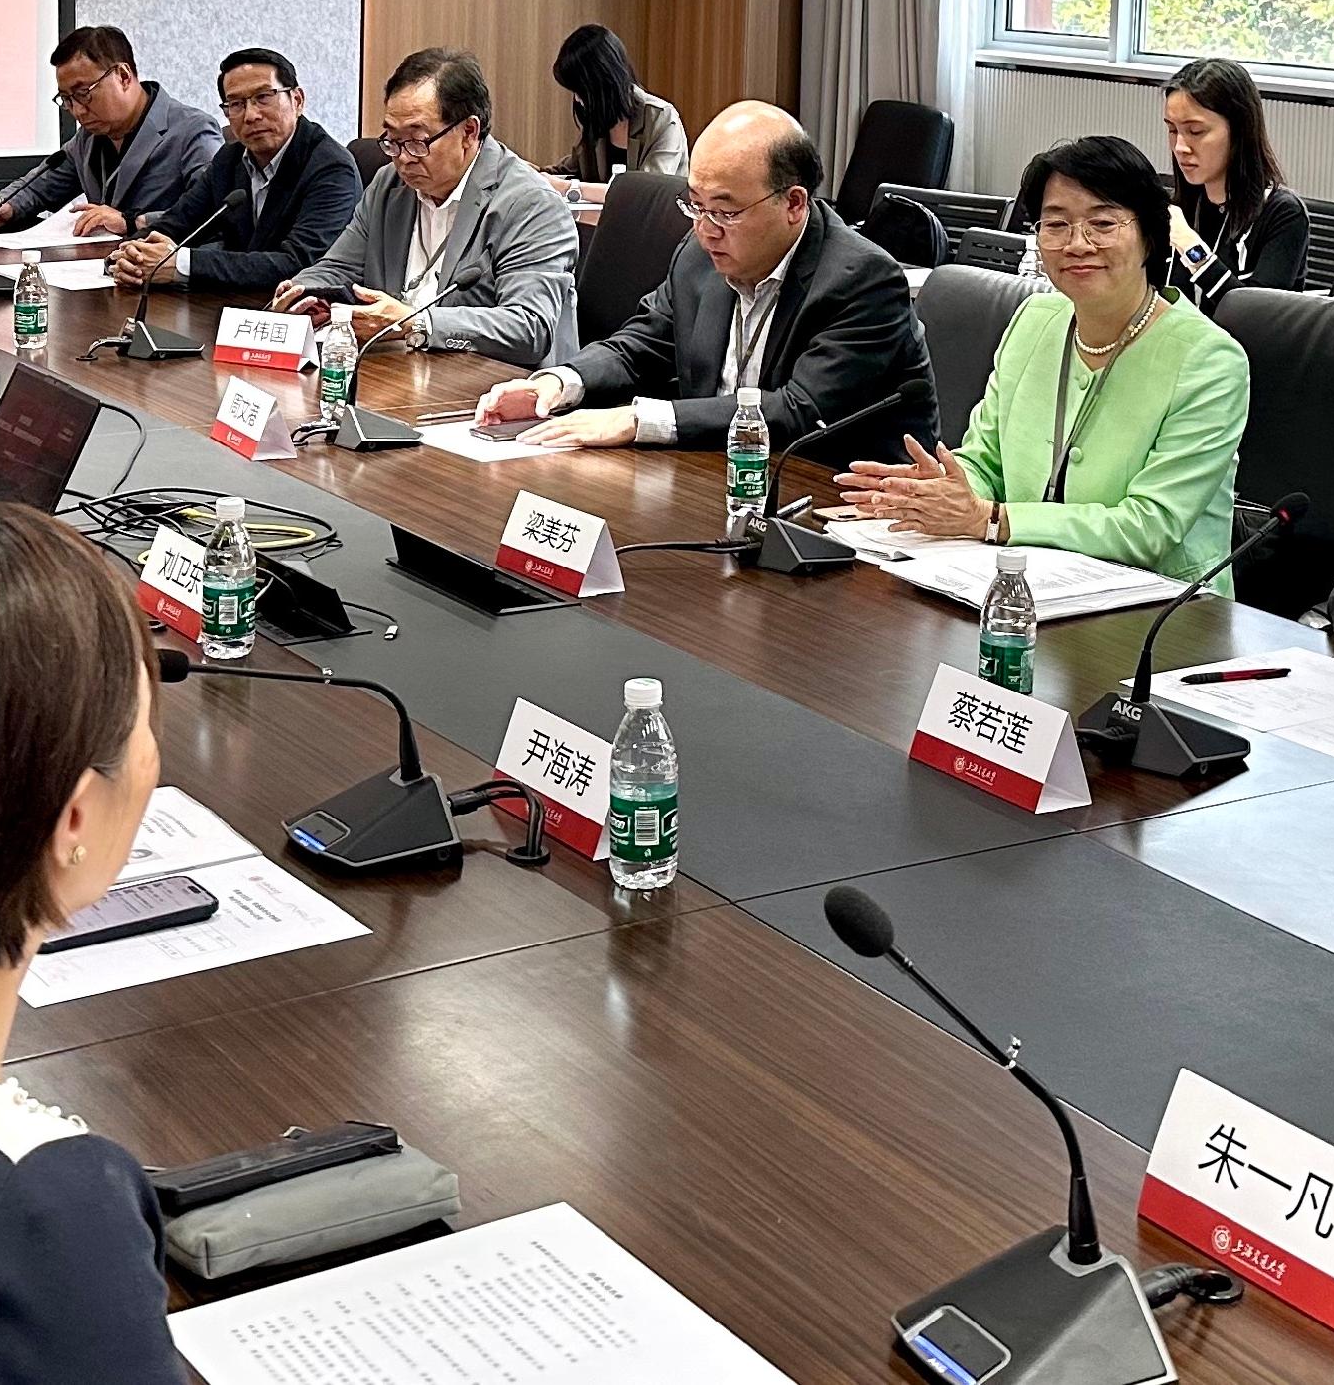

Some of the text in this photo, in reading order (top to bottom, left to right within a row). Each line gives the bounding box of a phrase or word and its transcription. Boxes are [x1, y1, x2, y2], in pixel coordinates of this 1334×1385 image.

[234, 318, 289, 343] 卢伟国
[522, 510, 581, 552] 梁美芬
[158, 547, 204, 594] 刘卫东
[948, 691, 1033, 754] 蔡若莲
[1111, 700, 1142, 722] AKG
[522, 729, 596, 796] 尹海涛
[1198, 1124, 1334, 1239] 朱一凡
